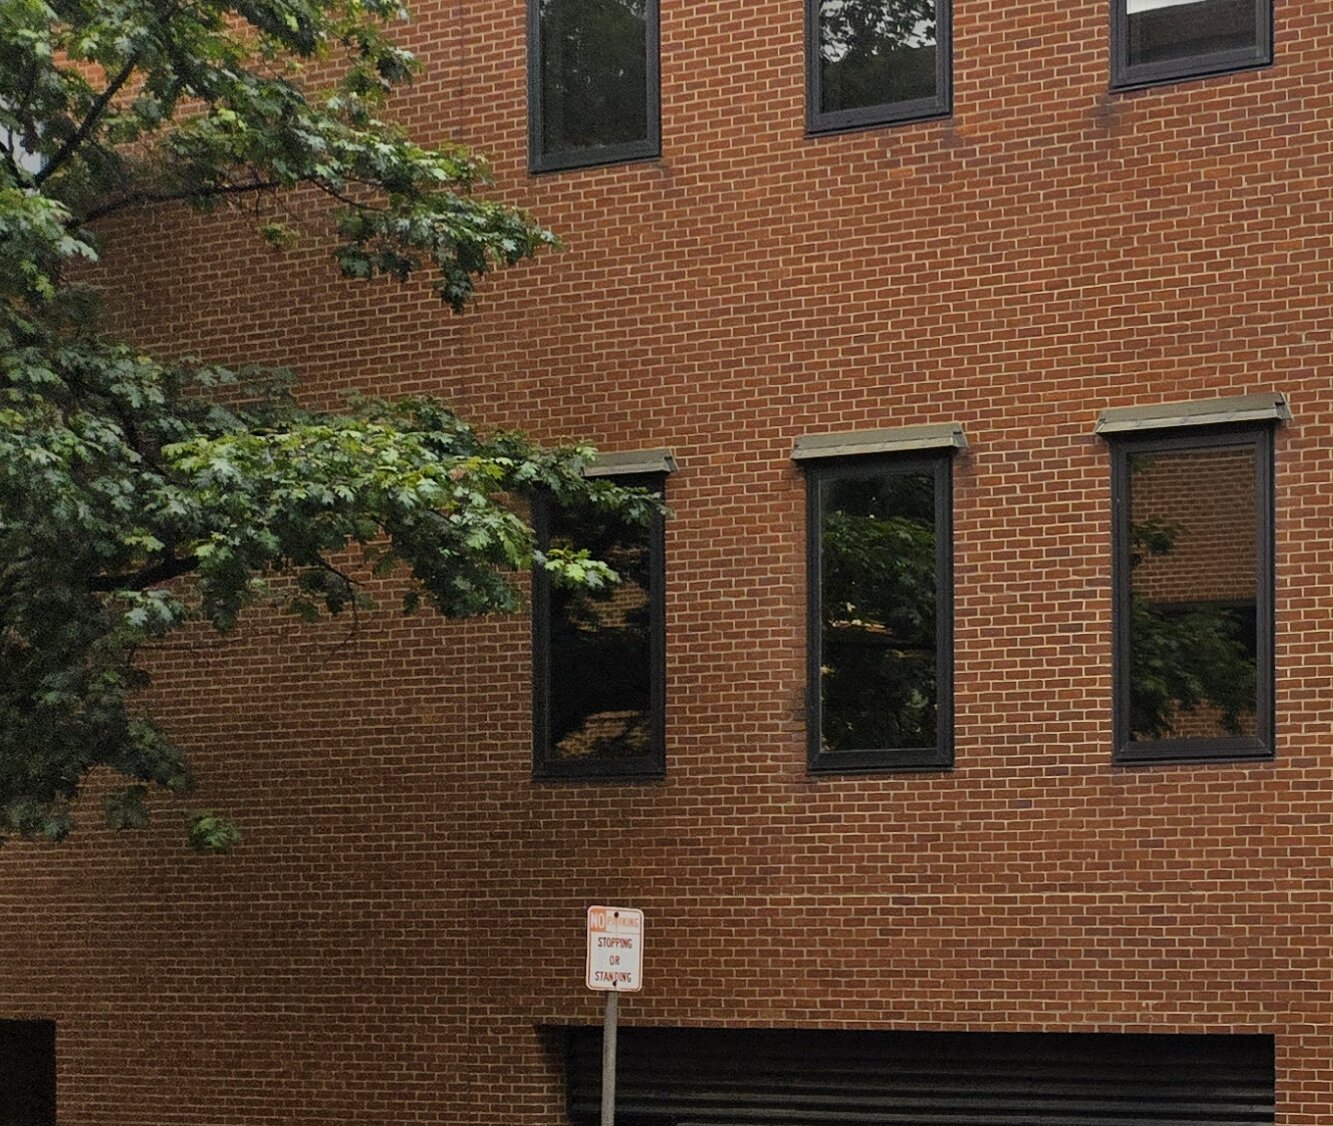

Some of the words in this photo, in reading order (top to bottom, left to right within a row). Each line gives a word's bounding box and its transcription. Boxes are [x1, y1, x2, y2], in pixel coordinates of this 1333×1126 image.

[590, 911, 605, 929] NO
[597, 937, 633, 949] STOPPING
[609, 955, 621, 966] OR
[594, 971, 632, 983] STANDING
